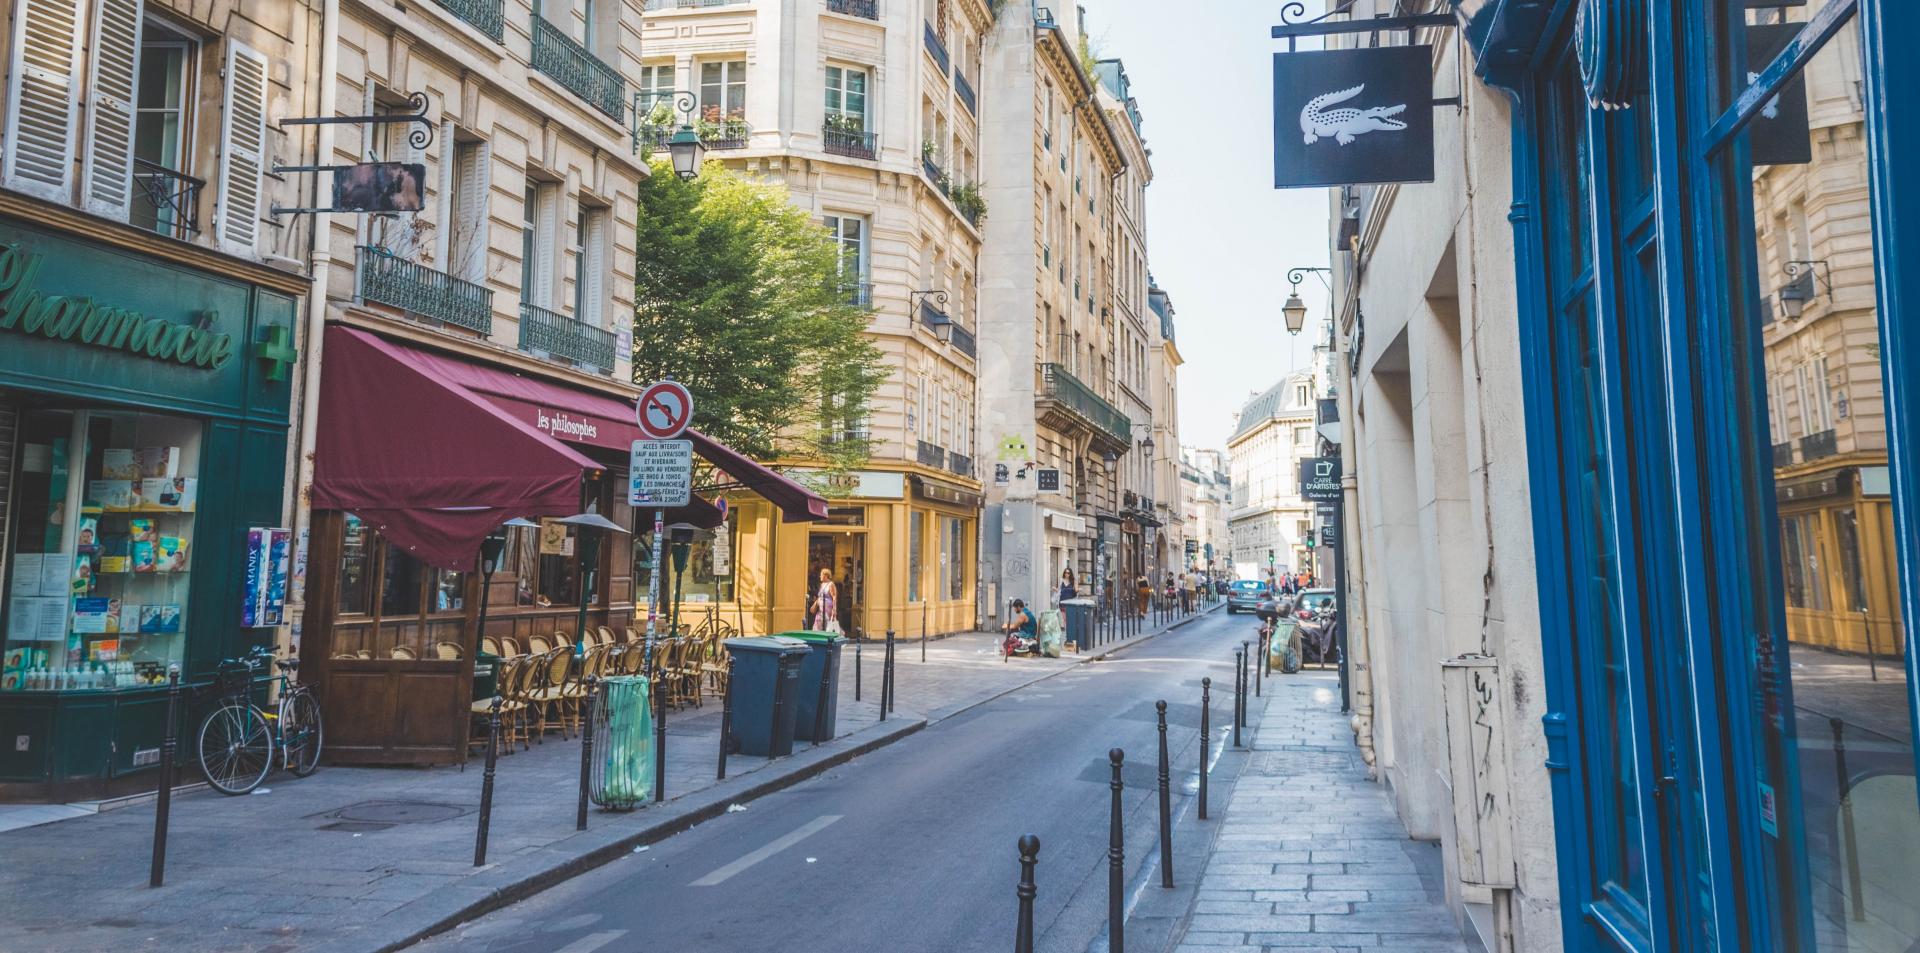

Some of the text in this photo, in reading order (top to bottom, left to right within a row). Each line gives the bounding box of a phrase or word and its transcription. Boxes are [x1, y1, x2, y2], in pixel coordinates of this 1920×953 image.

[537, 409, 597, 441] les philosophes
[247, 549, 257, 585] MANIX
